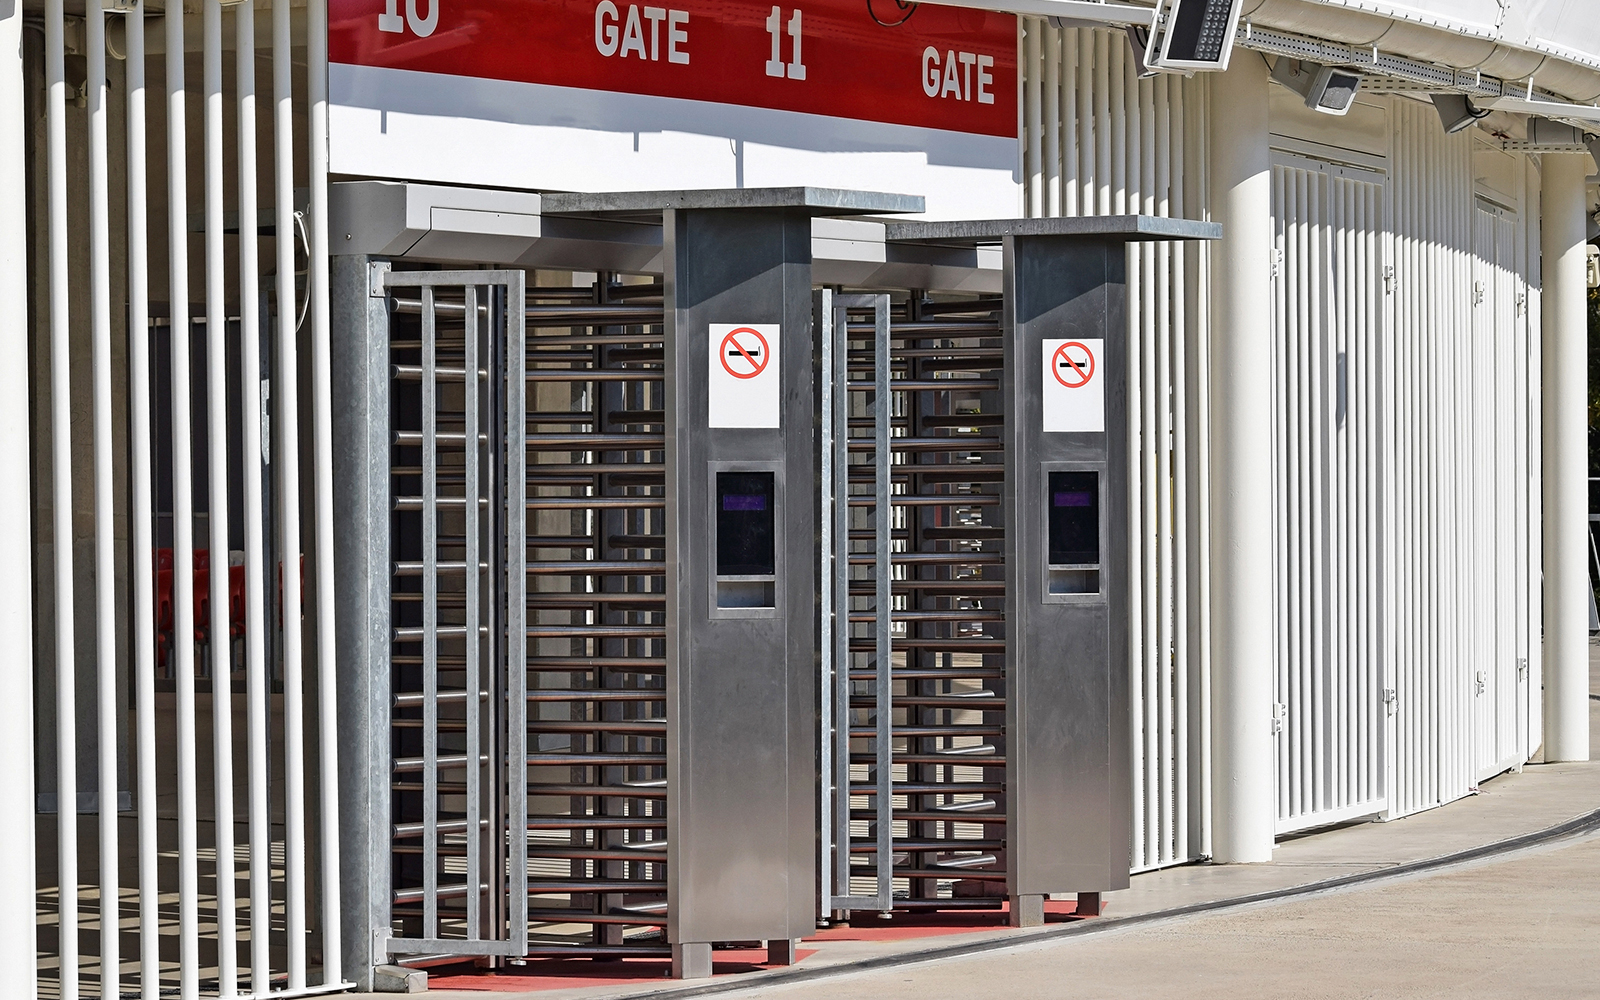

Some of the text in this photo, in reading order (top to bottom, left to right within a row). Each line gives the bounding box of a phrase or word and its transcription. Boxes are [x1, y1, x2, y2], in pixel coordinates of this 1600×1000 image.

[594, 0, 807, 81] GATE 11
[922, 45, 995, 105] GATE
